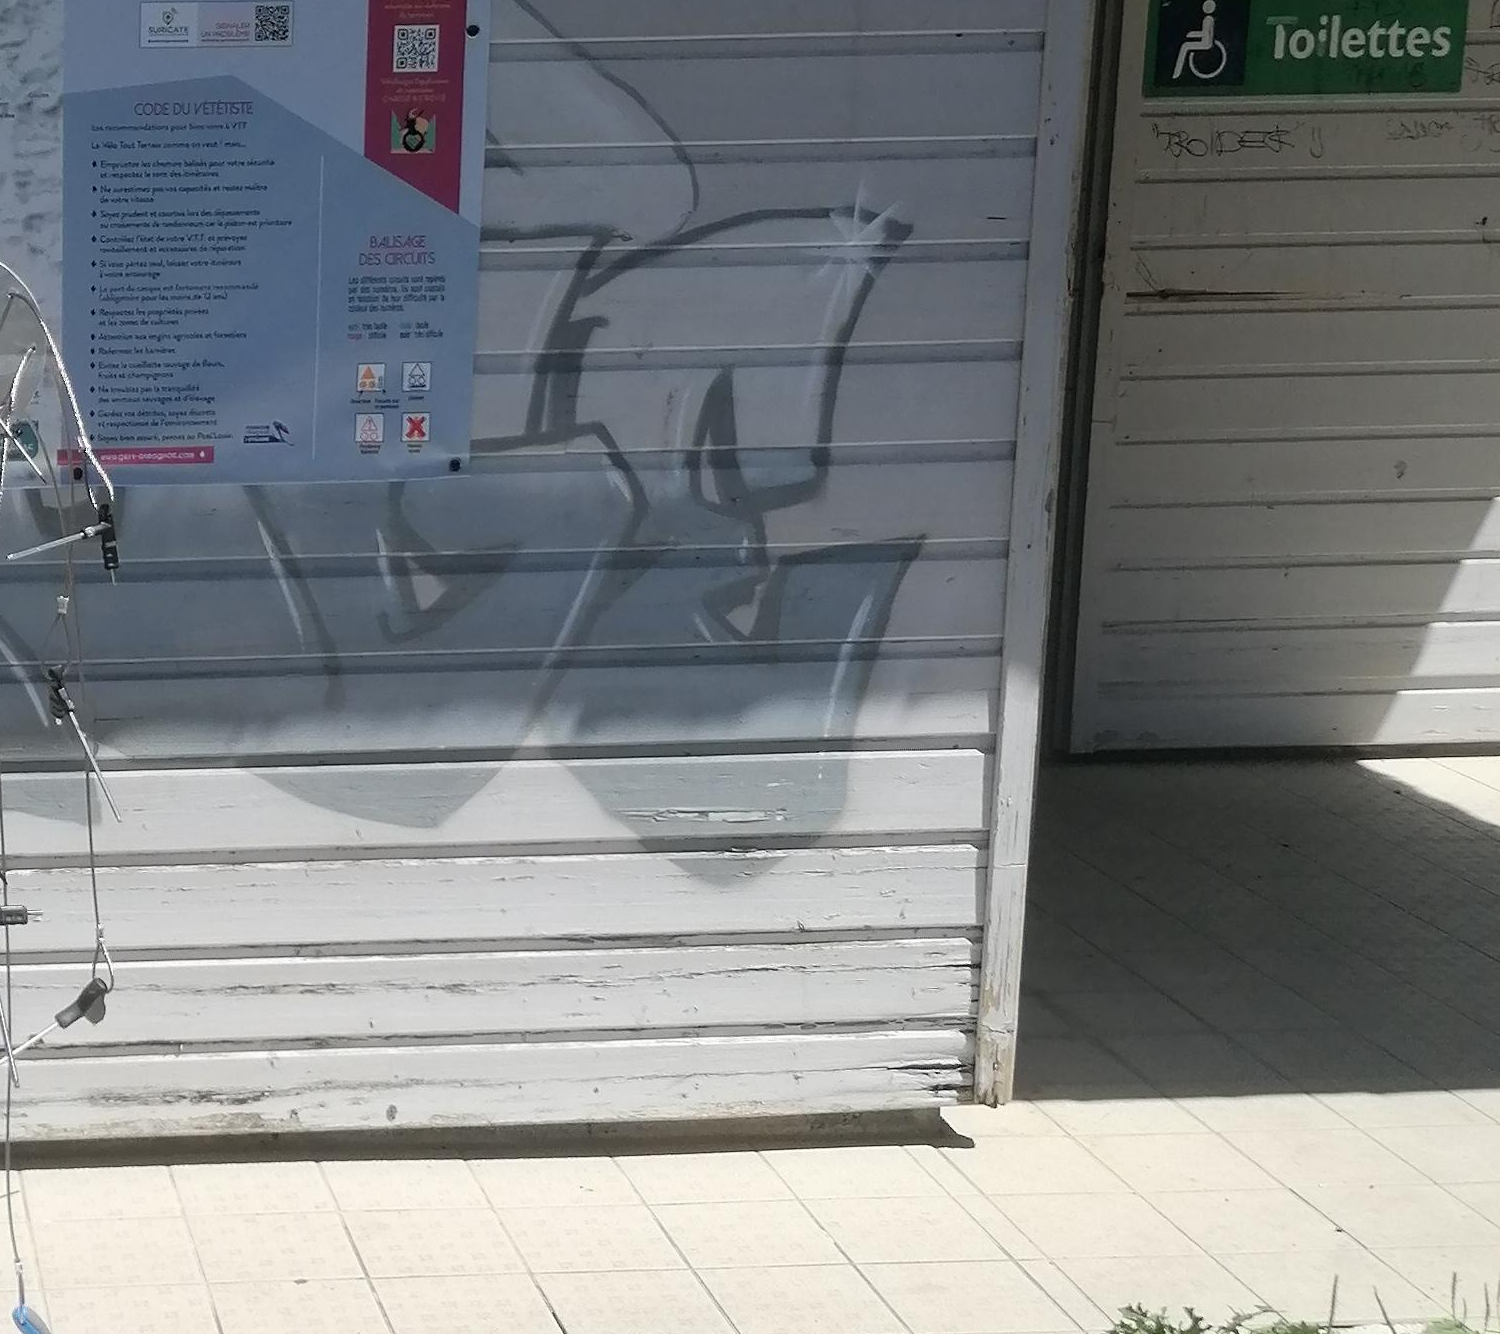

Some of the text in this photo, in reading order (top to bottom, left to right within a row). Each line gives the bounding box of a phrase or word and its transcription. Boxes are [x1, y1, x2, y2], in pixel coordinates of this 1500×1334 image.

[1267, 15, 1451, 59] Toilettes
[134, 102, 169, 115] CODE
[173, 102, 191, 115] DU
[370, 236, 426, 248] BALISAGE
[359, 252, 435, 265] DES CIRCUITS
